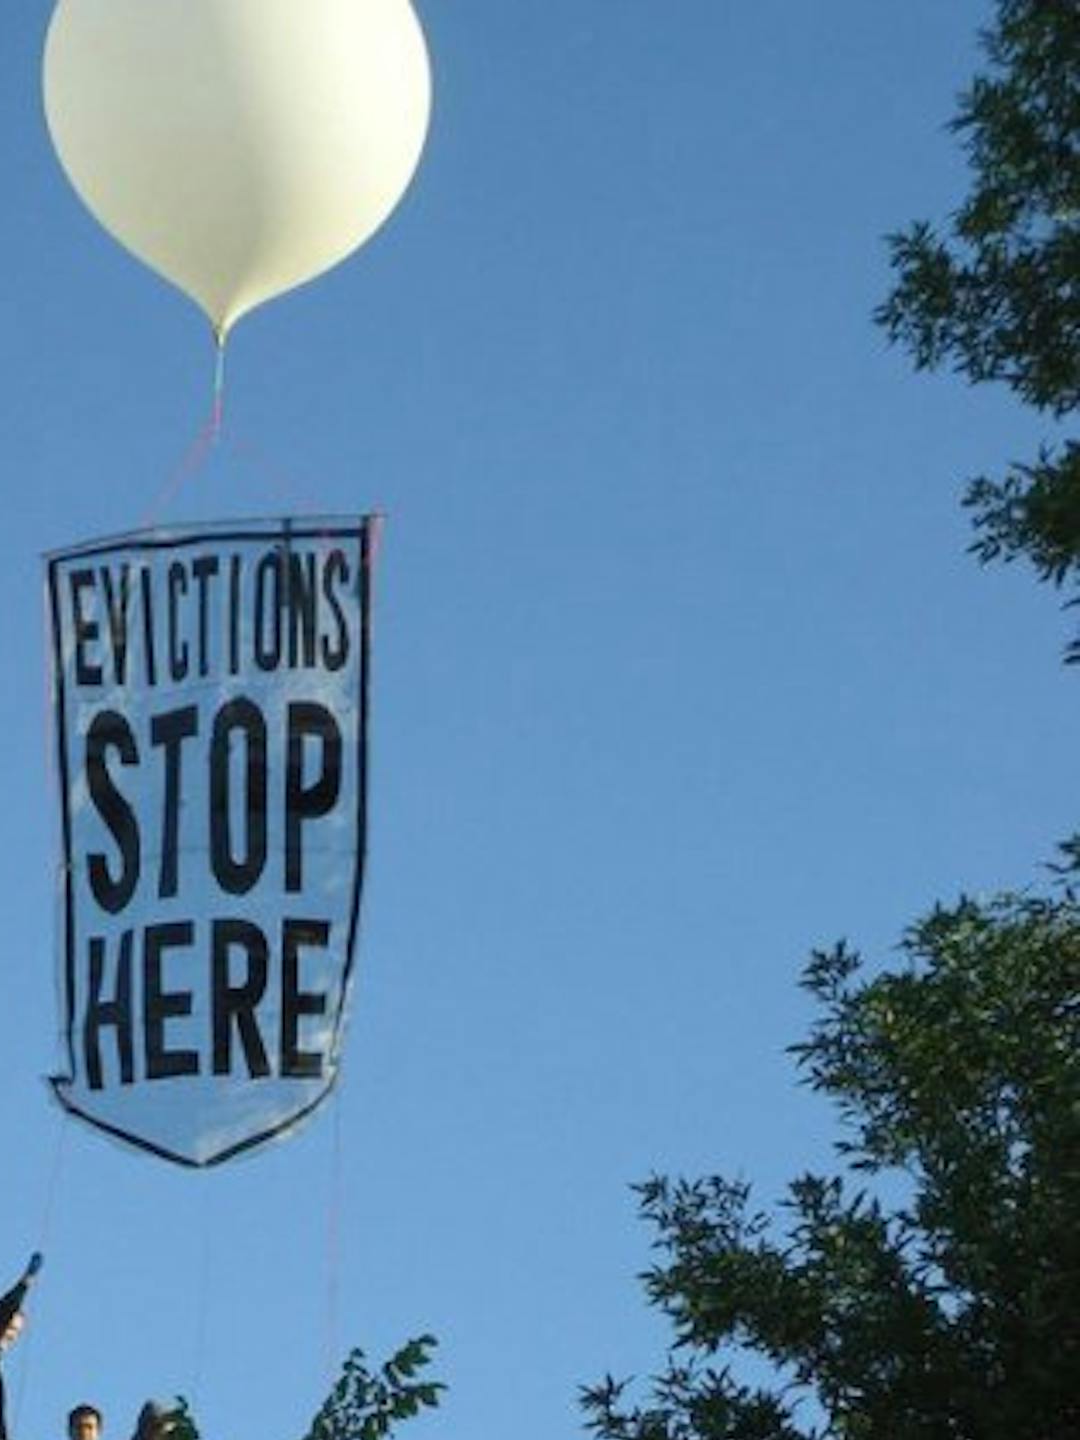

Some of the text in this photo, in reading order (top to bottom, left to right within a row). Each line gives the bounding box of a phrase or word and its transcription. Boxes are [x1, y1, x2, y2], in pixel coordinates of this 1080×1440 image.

[70, 549, 351, 686] EVICTIONS
[86, 696, 342, 914] STOP
[84, 918, 331, 1090] HERE
